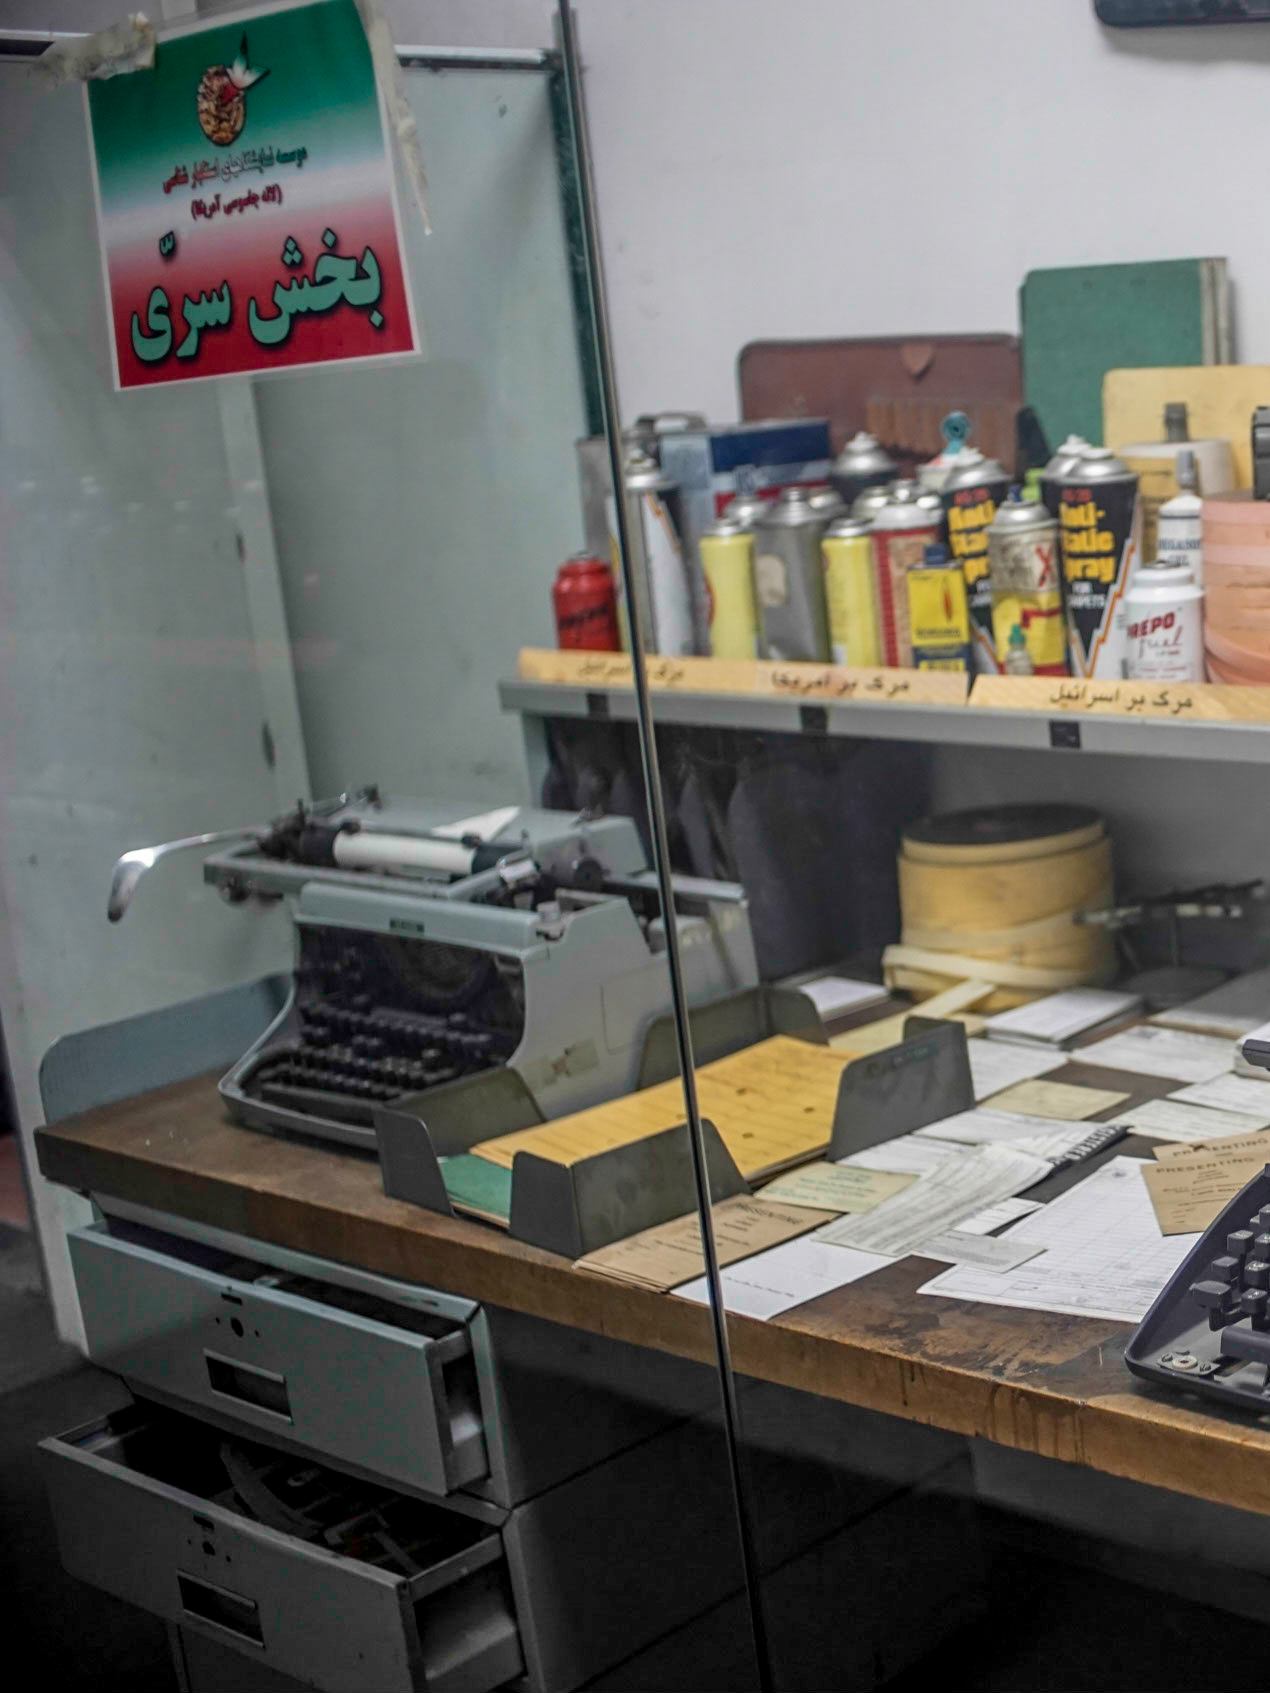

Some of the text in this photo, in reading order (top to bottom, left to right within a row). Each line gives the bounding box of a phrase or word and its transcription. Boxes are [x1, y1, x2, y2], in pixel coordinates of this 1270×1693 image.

[249, 228, 383, 346] بخش
[1172, 1138, 1268, 1157] PRENTING
[1156, 1157, 1255, 1174] PRESENTING
